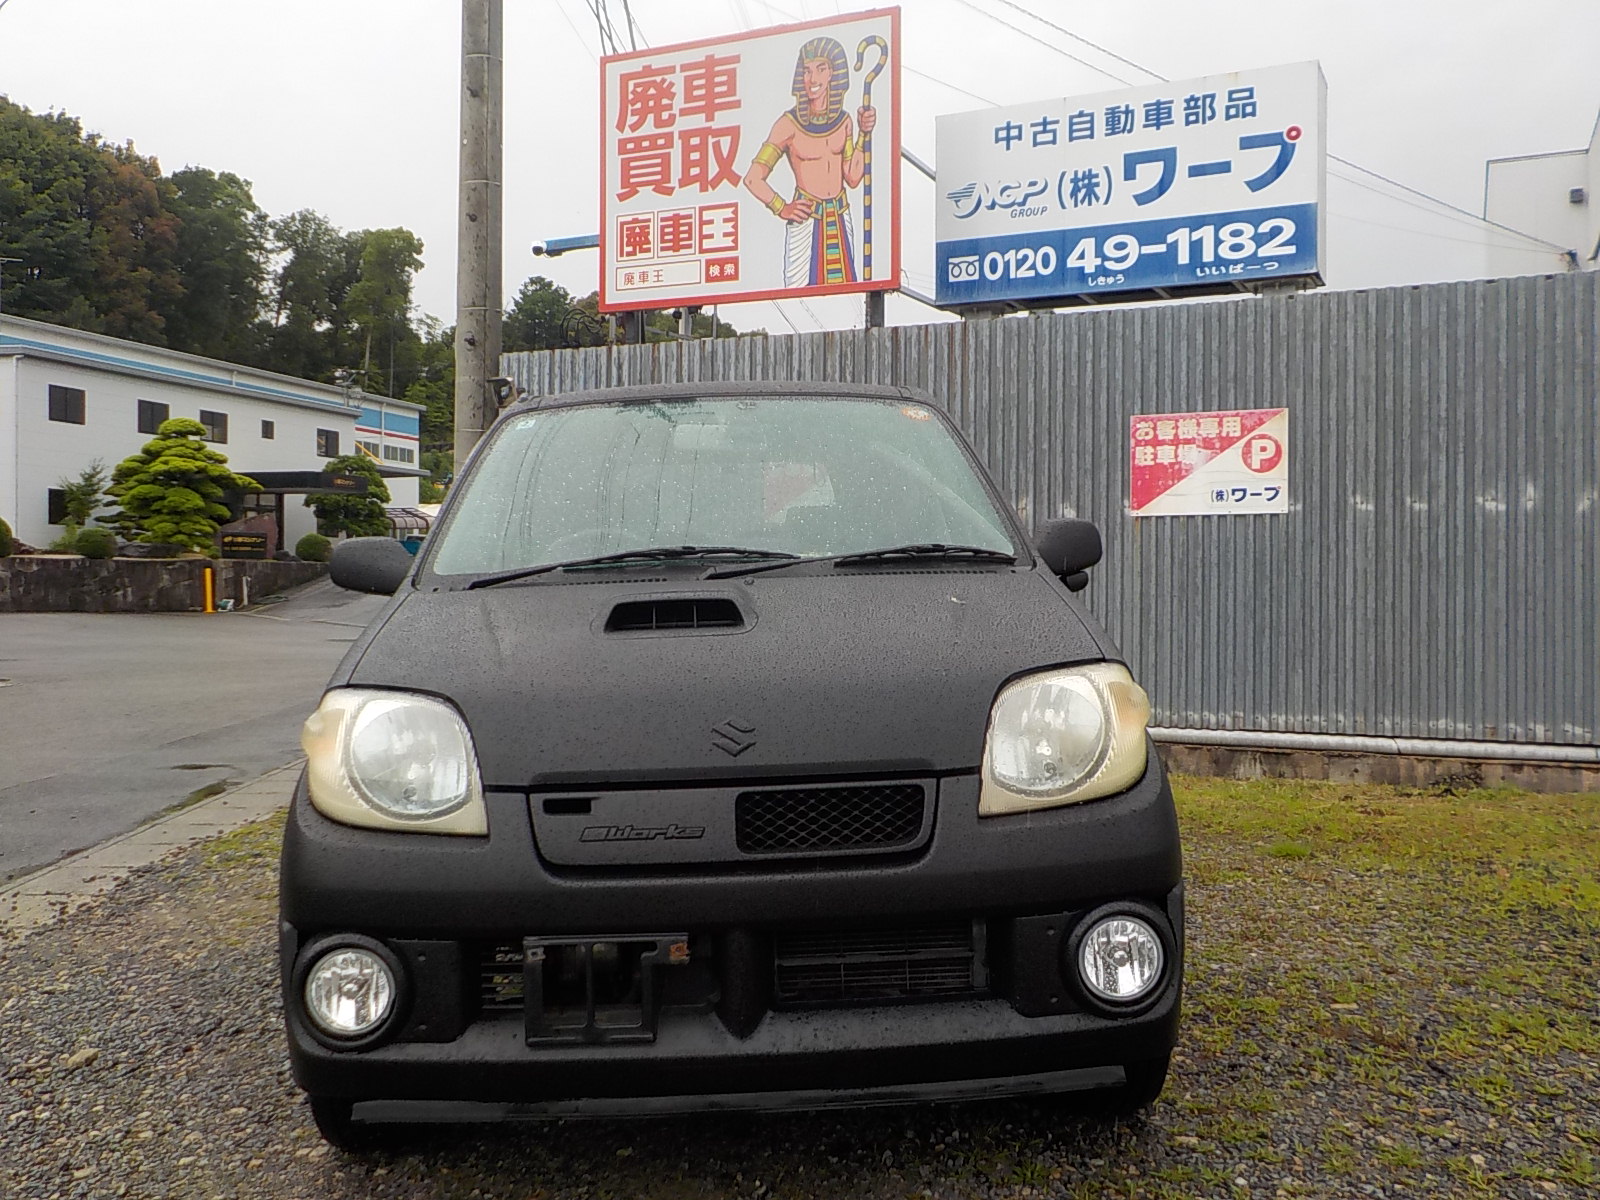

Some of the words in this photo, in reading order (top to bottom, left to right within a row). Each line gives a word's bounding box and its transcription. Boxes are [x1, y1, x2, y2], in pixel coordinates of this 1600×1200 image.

[615, 53, 742, 134] 廃車
[993, 86, 1258, 151] 中古自動車部品
[615, 125, 742, 202] 買取
[1010, 206, 1048, 219] GROUP
[619, 204, 737, 258] 廃車王
[983, 246, 1057, 281] 0120
[1066, 218, 1297, 274] 49-1182
[623, 269, 665, 286] 廃車王
[708, 263, 736, 278] 検索
[1087, 273, 1125, 287] しきゅう
[1135, 416, 1242, 441] お客様専用
[1251, 438, 1276, 469] P
